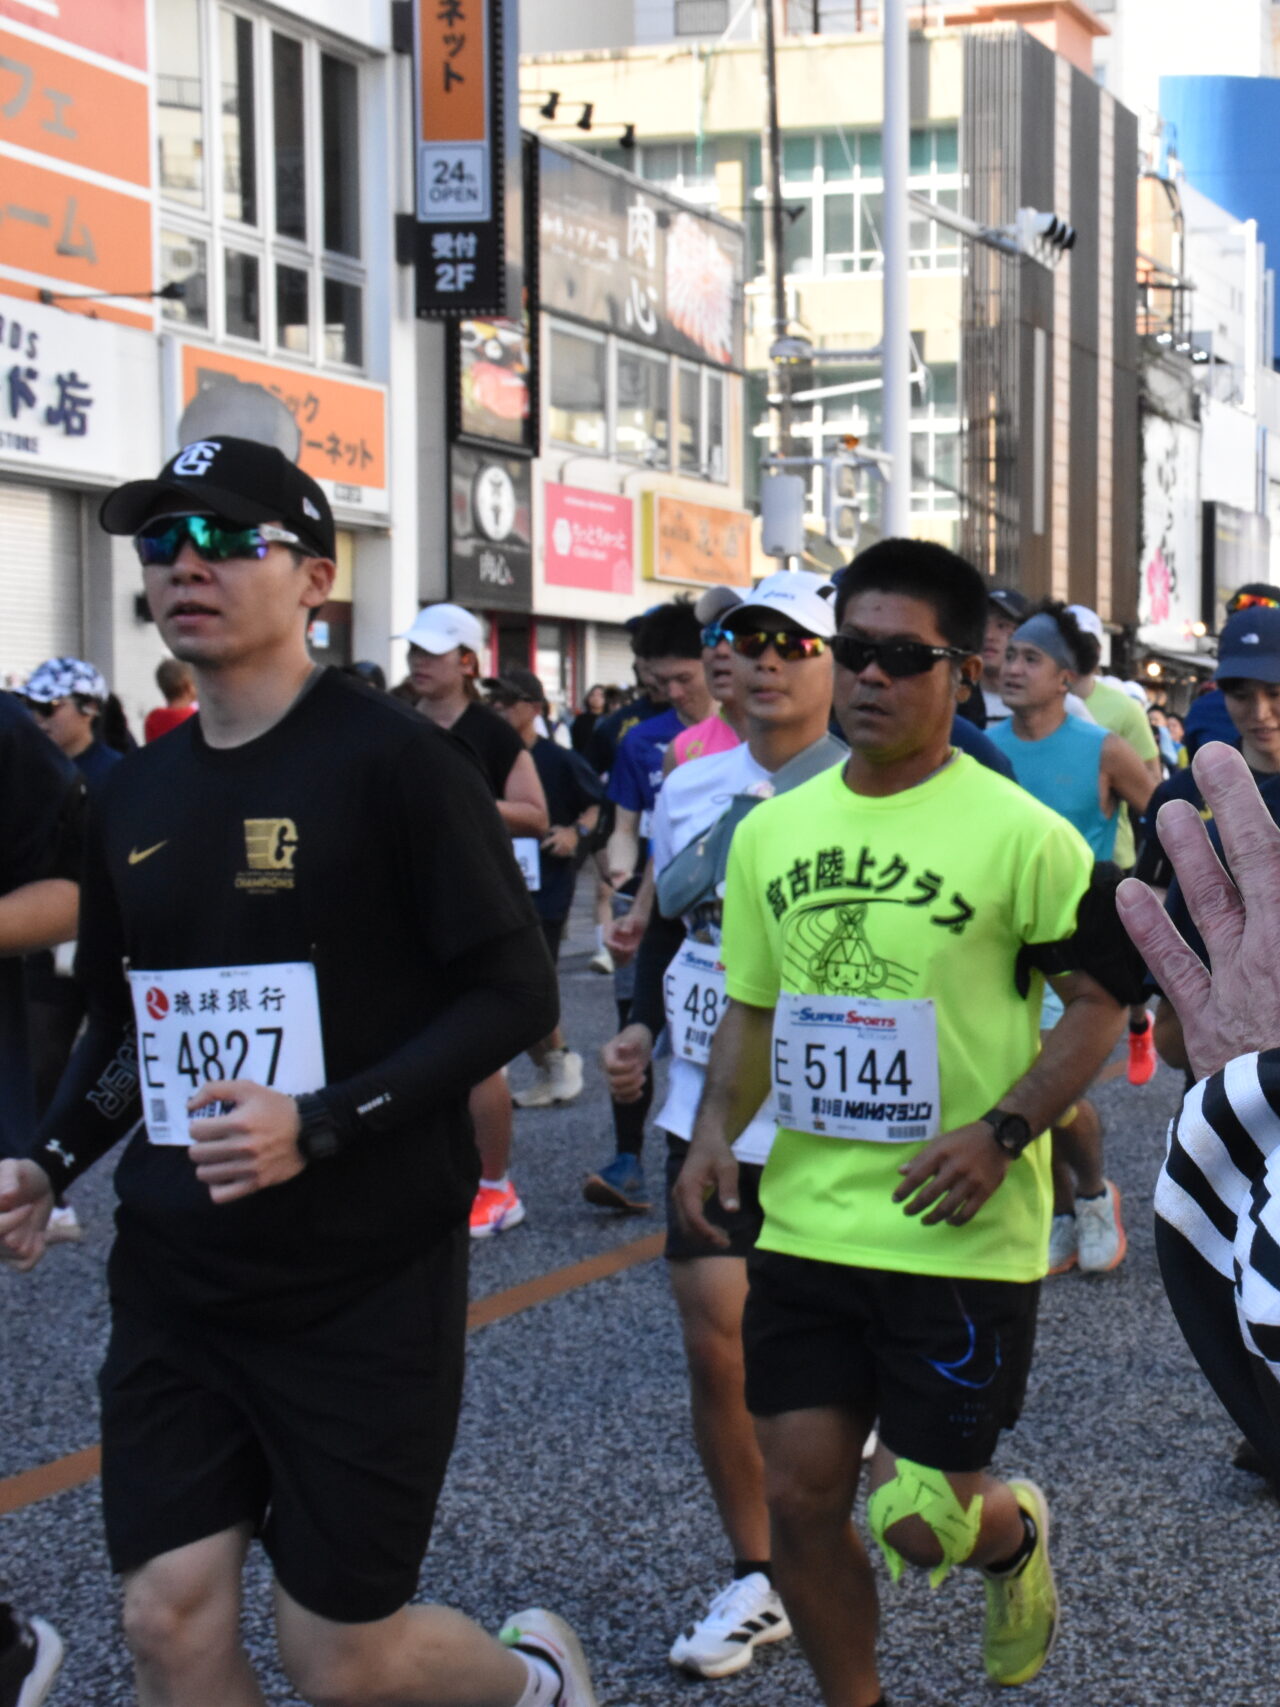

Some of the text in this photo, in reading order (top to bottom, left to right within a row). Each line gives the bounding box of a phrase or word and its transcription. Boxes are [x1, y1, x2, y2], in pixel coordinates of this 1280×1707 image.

[429, 186, 479, 202] OPEN
[0, 196, 98, 265] ーム
[431, 232, 477, 260] 受付
[434, 262, 476, 292] 2F
[174, 987, 286, 1016] 琉球銀行
[799, 1006, 896, 1028] SUPER SPORTS
[142, 1032, 165, 1088] E
[177, 1026, 283, 1088] 4827
[775, 1038, 912, 1096] E 5144
